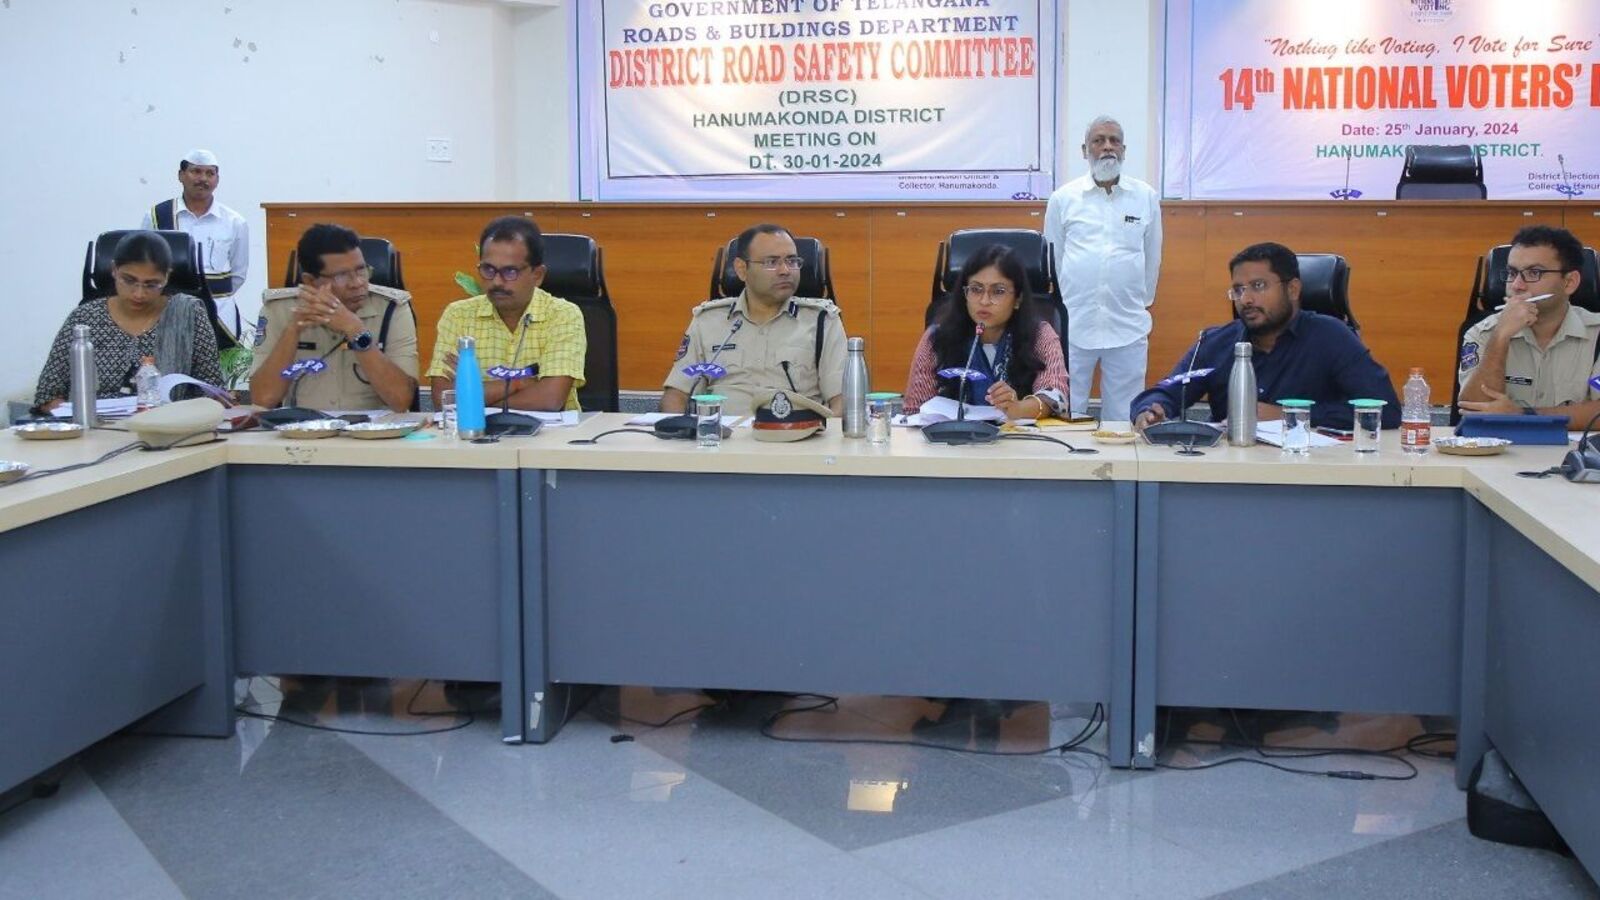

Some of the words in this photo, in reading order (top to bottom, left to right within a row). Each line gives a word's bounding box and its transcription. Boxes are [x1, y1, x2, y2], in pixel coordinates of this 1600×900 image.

[649, 0, 804, 18] GOVERNMENT
[813, 0, 840, 12] OF
[854, 0, 990, 11] TELANGANA
[623, 27, 697, 43] ROADS
[706, 25, 721, 40] &
[730, 21, 850, 39] BUILDINGS
[860, 16, 1019, 35] DEPARTMENT
[1345, 38, 1376, 55] like
[1453, 35, 1465, 53] I
[1469, 35, 1507, 53] Vote
[1513, 36, 1539, 58] for
[1547, 35, 1593, 53] Sure
[608, 49, 714, 88] DISTRICT
[722, 45, 787, 84] ROAD
[793, 41, 882, 82] SAFETY
[891, 37, 1036, 80] COMMITTEE
[1219, 67, 1275, 110] 14th
[1283, 66, 1437, 110] NATIONAL
[1445, 63, 1582, 109] VOTERS'
[778, 89, 858, 106] (DRSC)
[693, 111, 849, 128] HANUMAKONDA
[854, 108, 946, 124] DISTRICT
[1341, 124, 1380, 137] Date:
[1385, 123, 1411, 136] 25th
[1415, 123, 1479, 137] January,
[1484, 122, 1520, 136] 2024
[754, 132, 841, 148] MEETING
[847, 131, 876, 146] ON
[783, 153, 882, 169] 30-01-2024
